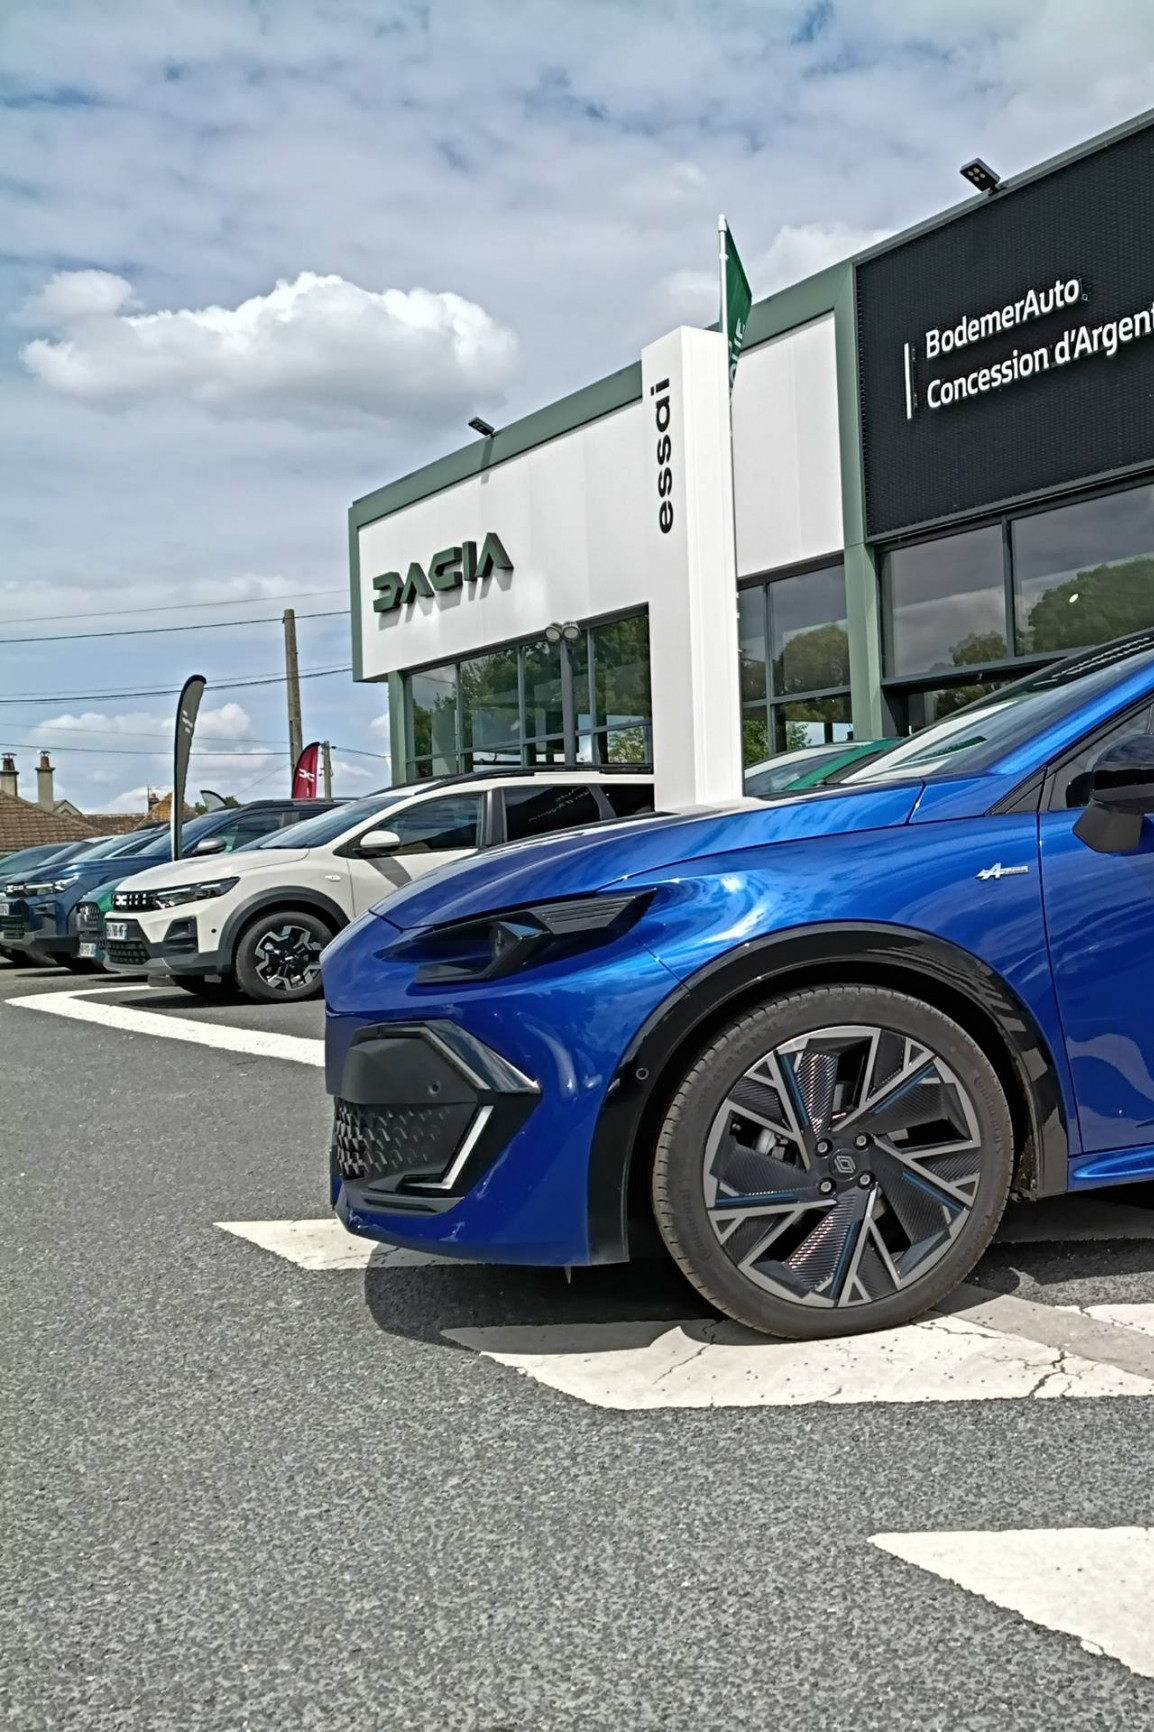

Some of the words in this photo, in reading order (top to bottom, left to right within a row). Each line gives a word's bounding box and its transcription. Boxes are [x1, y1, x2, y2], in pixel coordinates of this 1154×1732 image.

[925, 278, 1080, 359] BodemerAuto
[927, 348, 1050, 409] Concession
[651, 377, 674, 534] essai
[372, 532, 514, 613] DACIA
